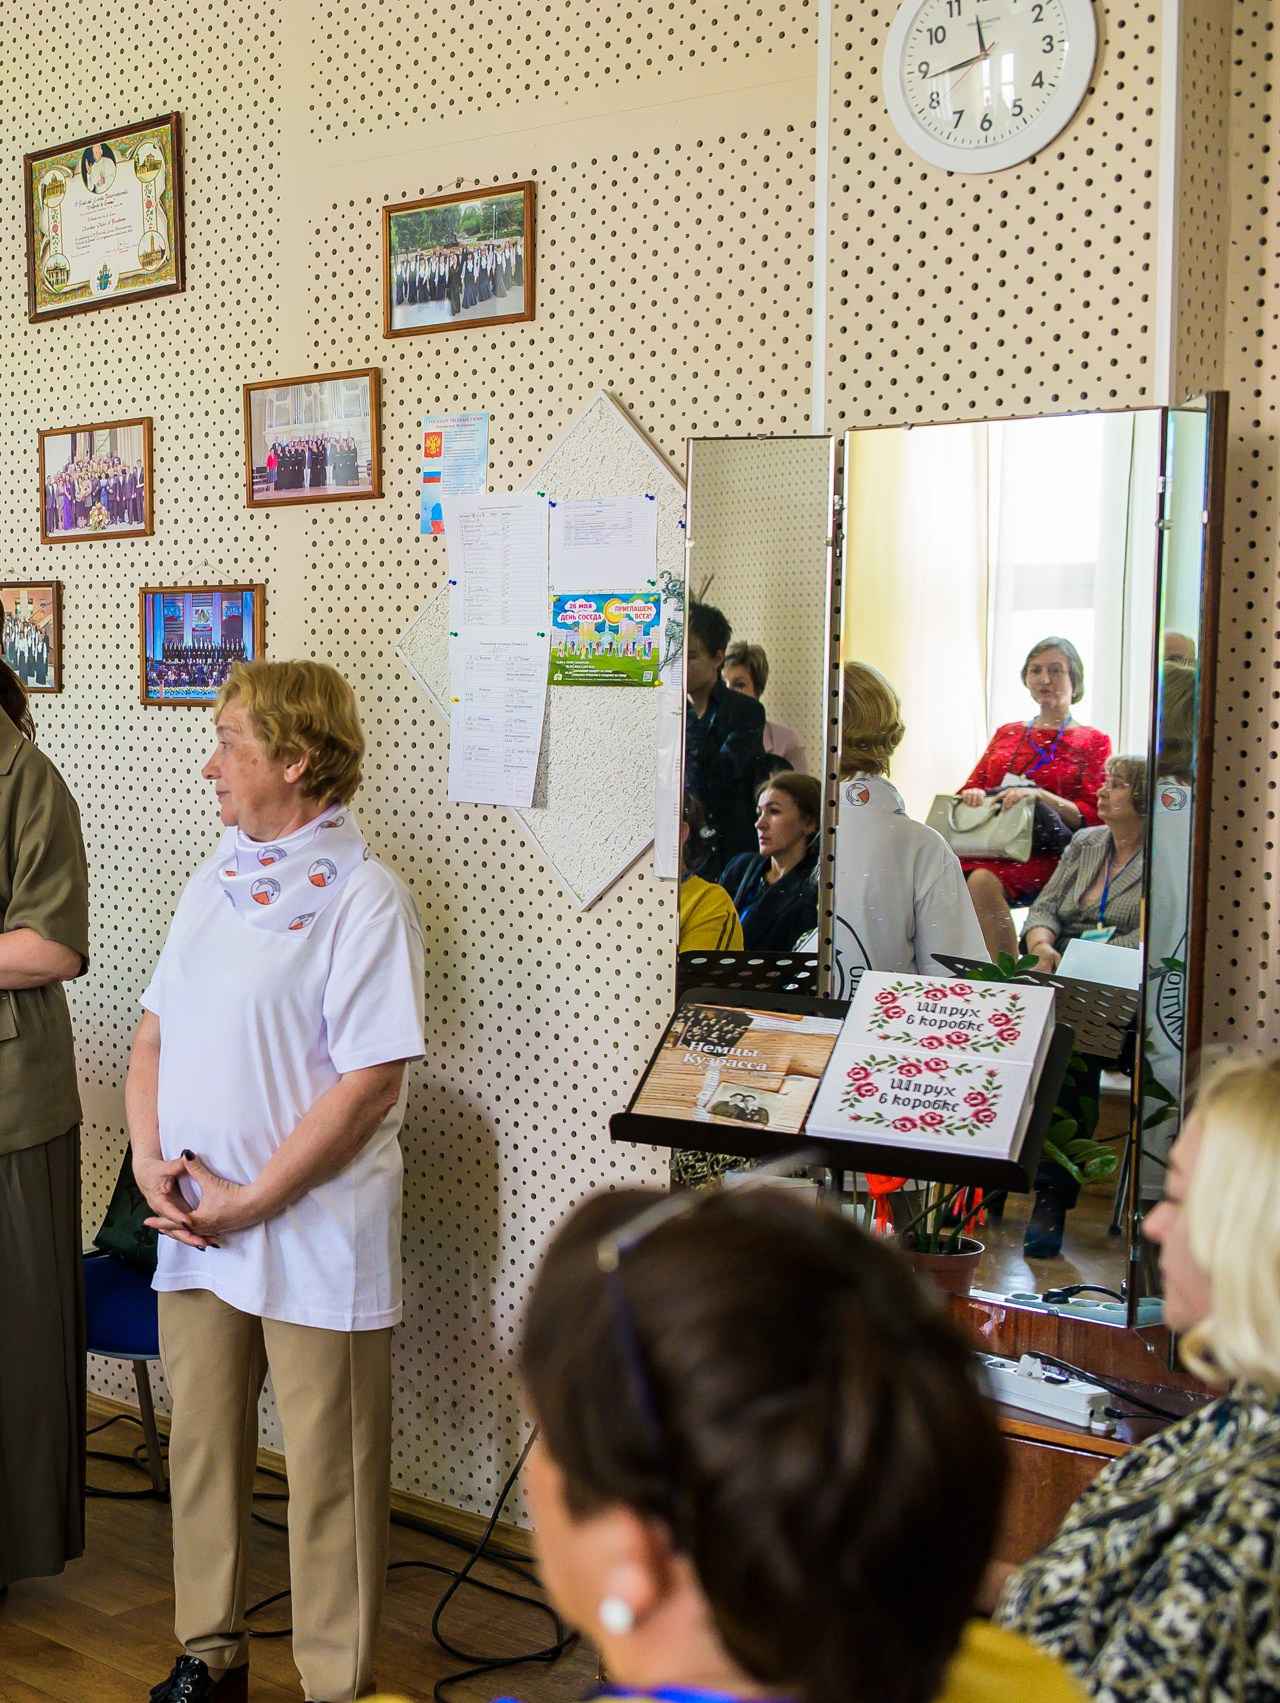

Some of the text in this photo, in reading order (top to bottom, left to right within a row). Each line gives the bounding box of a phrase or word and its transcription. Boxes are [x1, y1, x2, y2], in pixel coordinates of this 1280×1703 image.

[1031, 4, 1044, 23] 2
[926, 25, 946, 45] 10
[1041, 35, 1054, 54] 3
[918, 61, 930, 80] 9
[1031, 70, 1045, 89] 4
[929, 91, 940, 110] 8
[1012, 98, 1023, 117] 5
[952, 109, 965, 129] 7
[980, 113, 992, 131] 6
[917, 1001, 981, 1018] Шпрух
[918, 1015, 985, 1032] коробке
[688, 1041, 759, 1057] Немцы
[682, 1053, 768, 1071] Кузбасса
[890, 1078, 956, 1098] Шпрух
[891, 1094, 960, 1113] коробке
